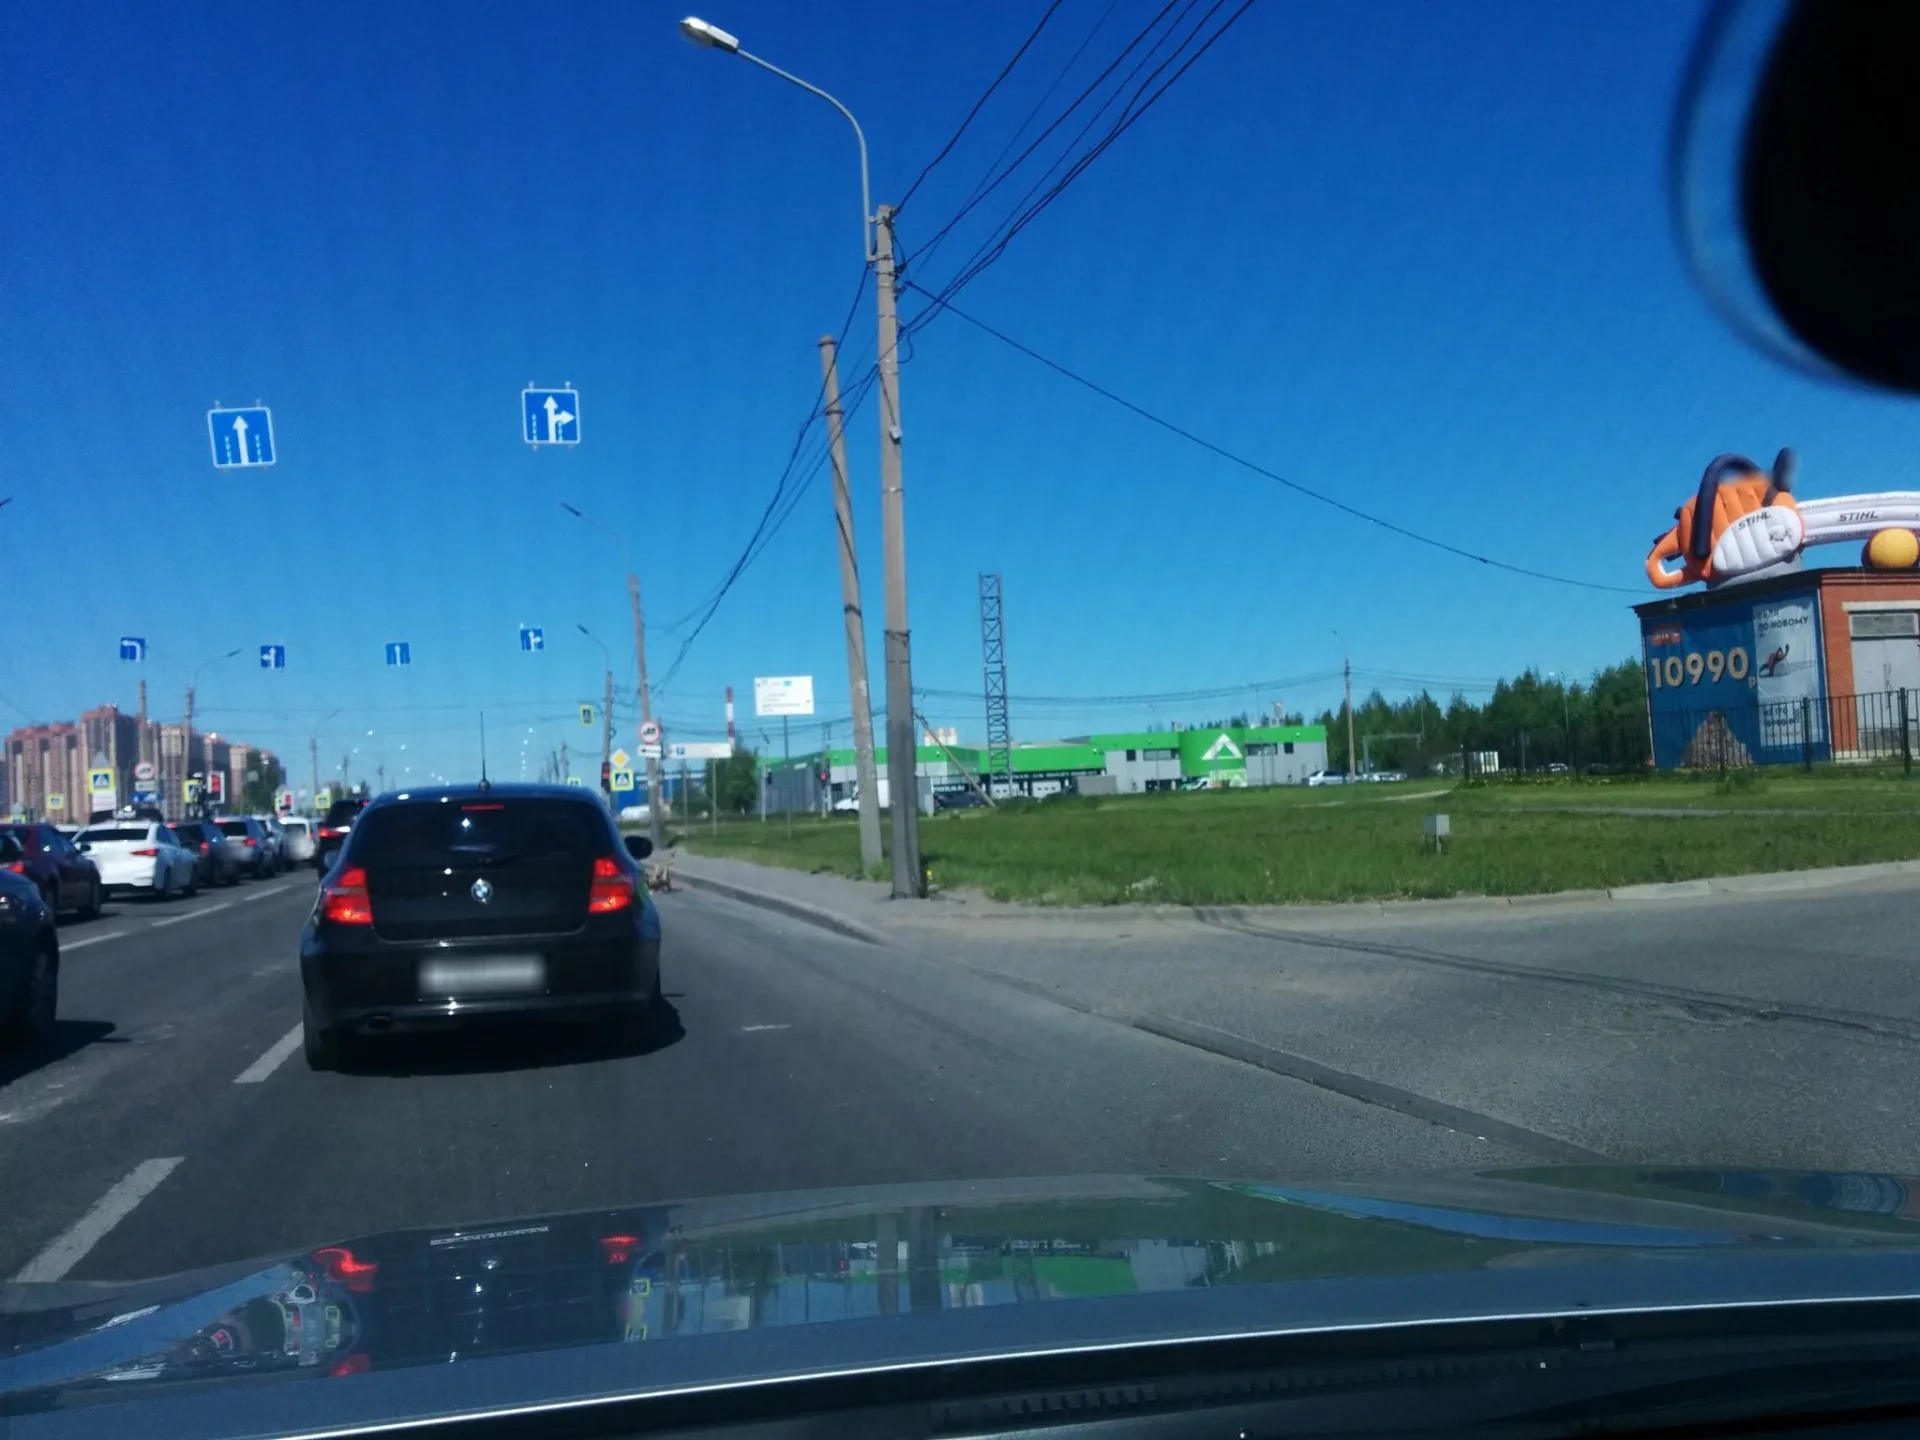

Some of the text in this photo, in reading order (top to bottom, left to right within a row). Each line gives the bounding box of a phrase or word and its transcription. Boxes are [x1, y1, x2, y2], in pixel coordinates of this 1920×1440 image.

[1738, 511, 1771, 529] STIHL
[1839, 510, 1879, 522] STIHL
[1651, 646, 1749, 688] 10990
